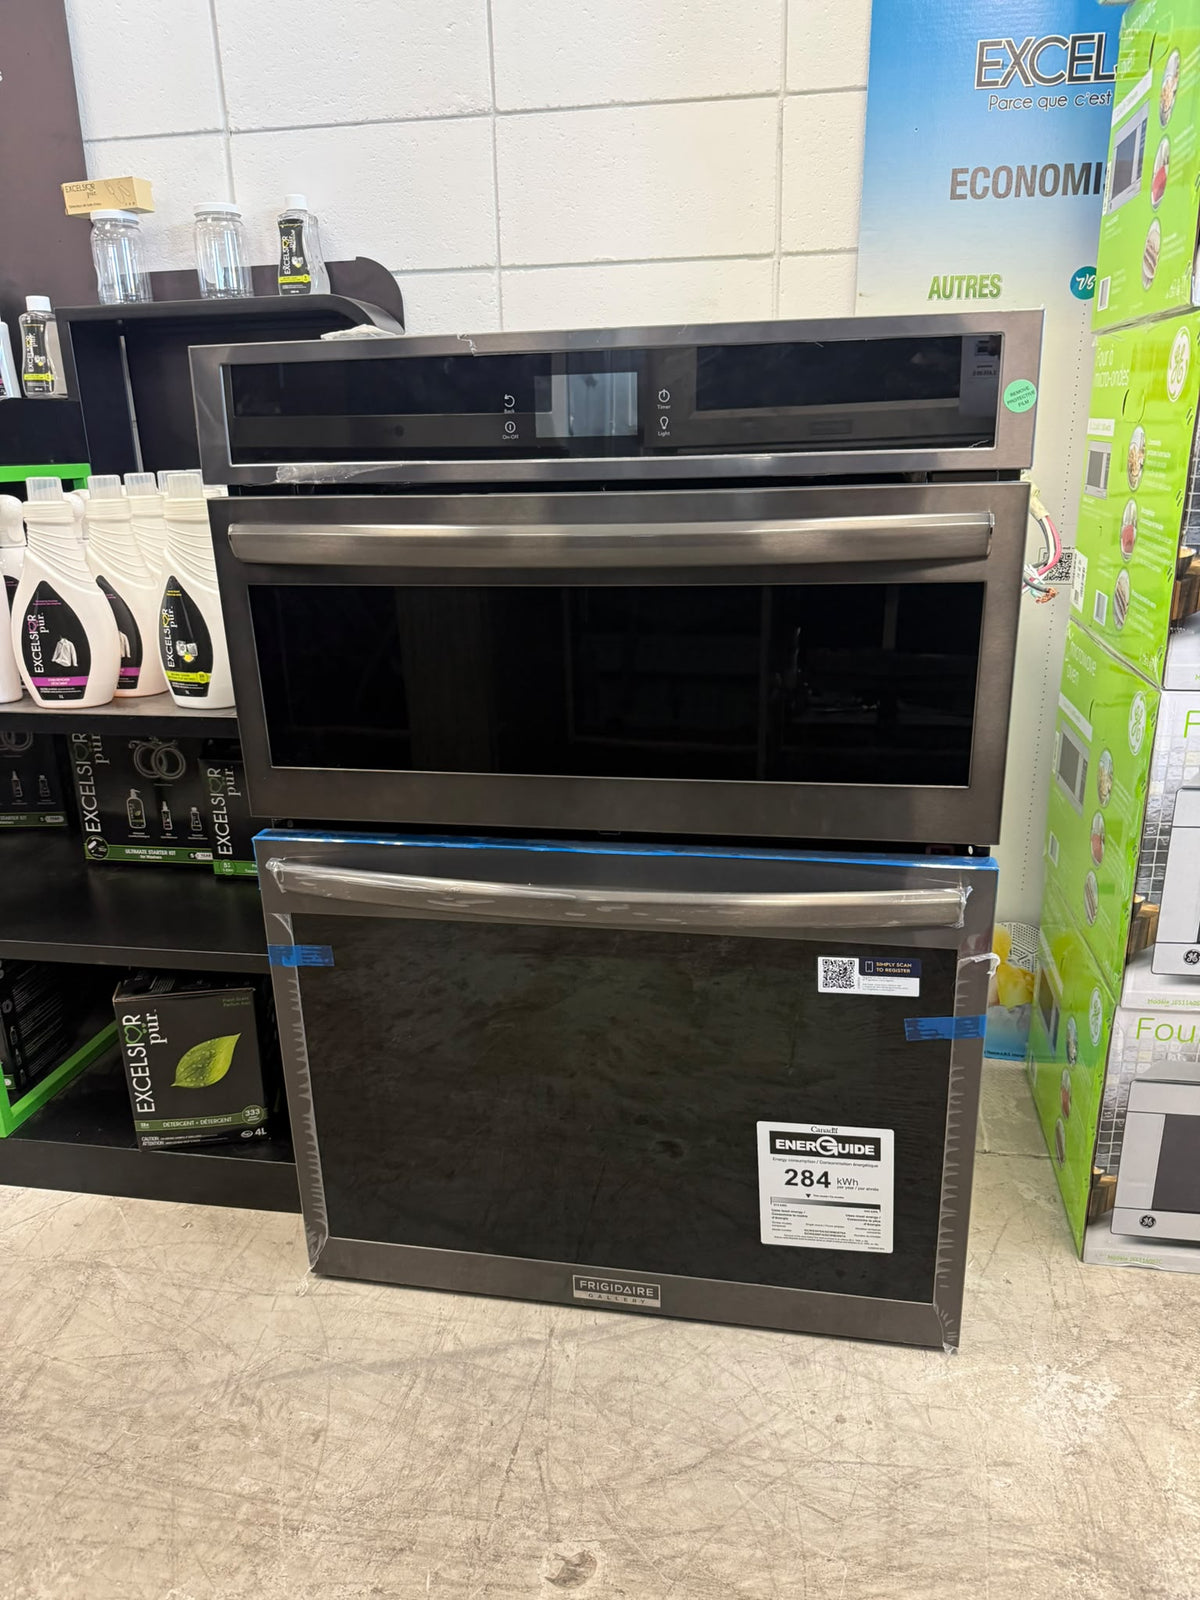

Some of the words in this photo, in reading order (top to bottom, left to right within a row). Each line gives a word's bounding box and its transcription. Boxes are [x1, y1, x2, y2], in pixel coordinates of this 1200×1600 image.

[974, 32, 1118, 90] EXCEL
[988, 94, 1032, 111] Parce
[1037, 95, 1067, 110] que
[1074, 90, 1112, 107] c'est
[949, 162, 1106, 200] ECONOMI
[927, 273, 1003, 300] AUTRES
[1006, 389, 1036, 405] PROTECTIVE
[1009, 386, 1030, 397] REMOVE
[1017, 399, 1030, 407] FILM
[27, 614, 45, 673] EXCELSIOR
[161, 608, 176, 668] EXCELSIOR
[72, 732, 102, 833] EXCELSIOR
[207, 767, 233, 855] EXCELSIOR
[1136, 1017, 1200, 1043] Fou
[122, 1013, 156, 1114] EXCELSIOR
[244, 1108, 260, 1117] 333
[163, 1120, 195, 1128] DETERGENT
[254, 1127, 267, 1136] 4L
[775, 1136, 875, 1156] ENERGUIDE
[784, 1168, 831, 1188] 284
[836, 1177, 859, 1186] kWh
[579, 1280, 654, 1297] FRIGIDAIRE
[588, 1292, 646, 1304] GALLERY
